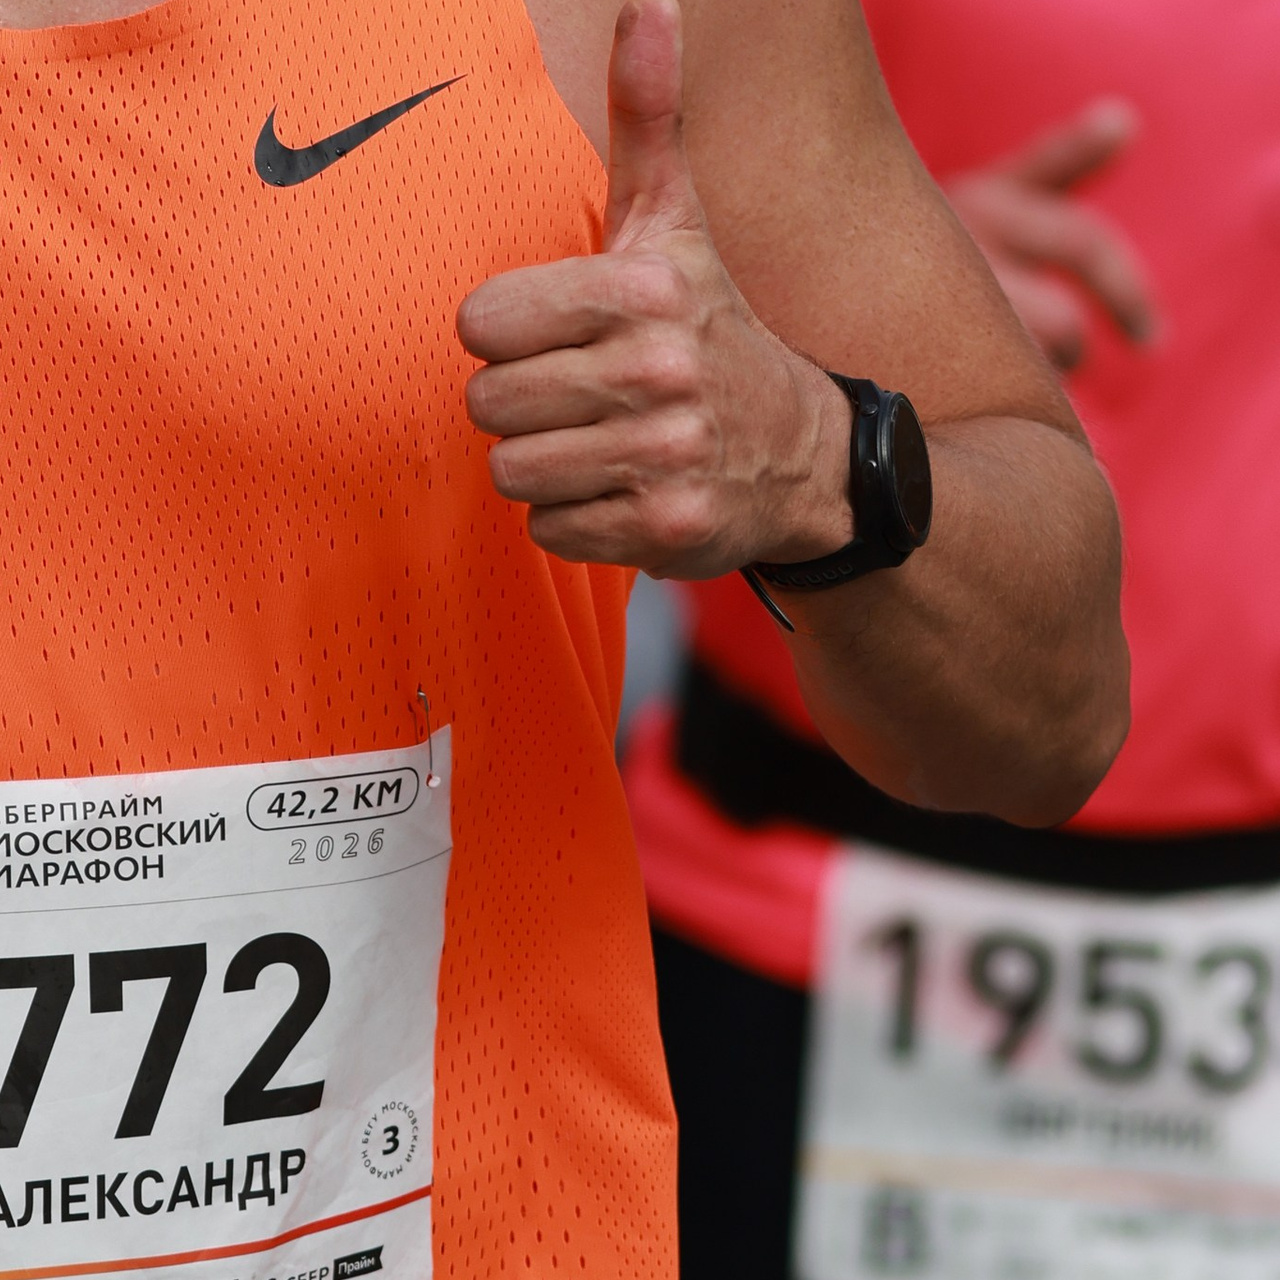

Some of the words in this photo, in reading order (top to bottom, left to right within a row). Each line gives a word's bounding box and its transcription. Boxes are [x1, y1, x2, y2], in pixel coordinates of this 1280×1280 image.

[267, 787, 338, 819] 42,2
[353, 778, 404, 810] КМ
[289, 828, 385, 864] 2026
[861, 917, 1272, 1094] 1953
[382, 1125, 400, 1156] 3
[338, 1255, 375, 1275] Прайм
